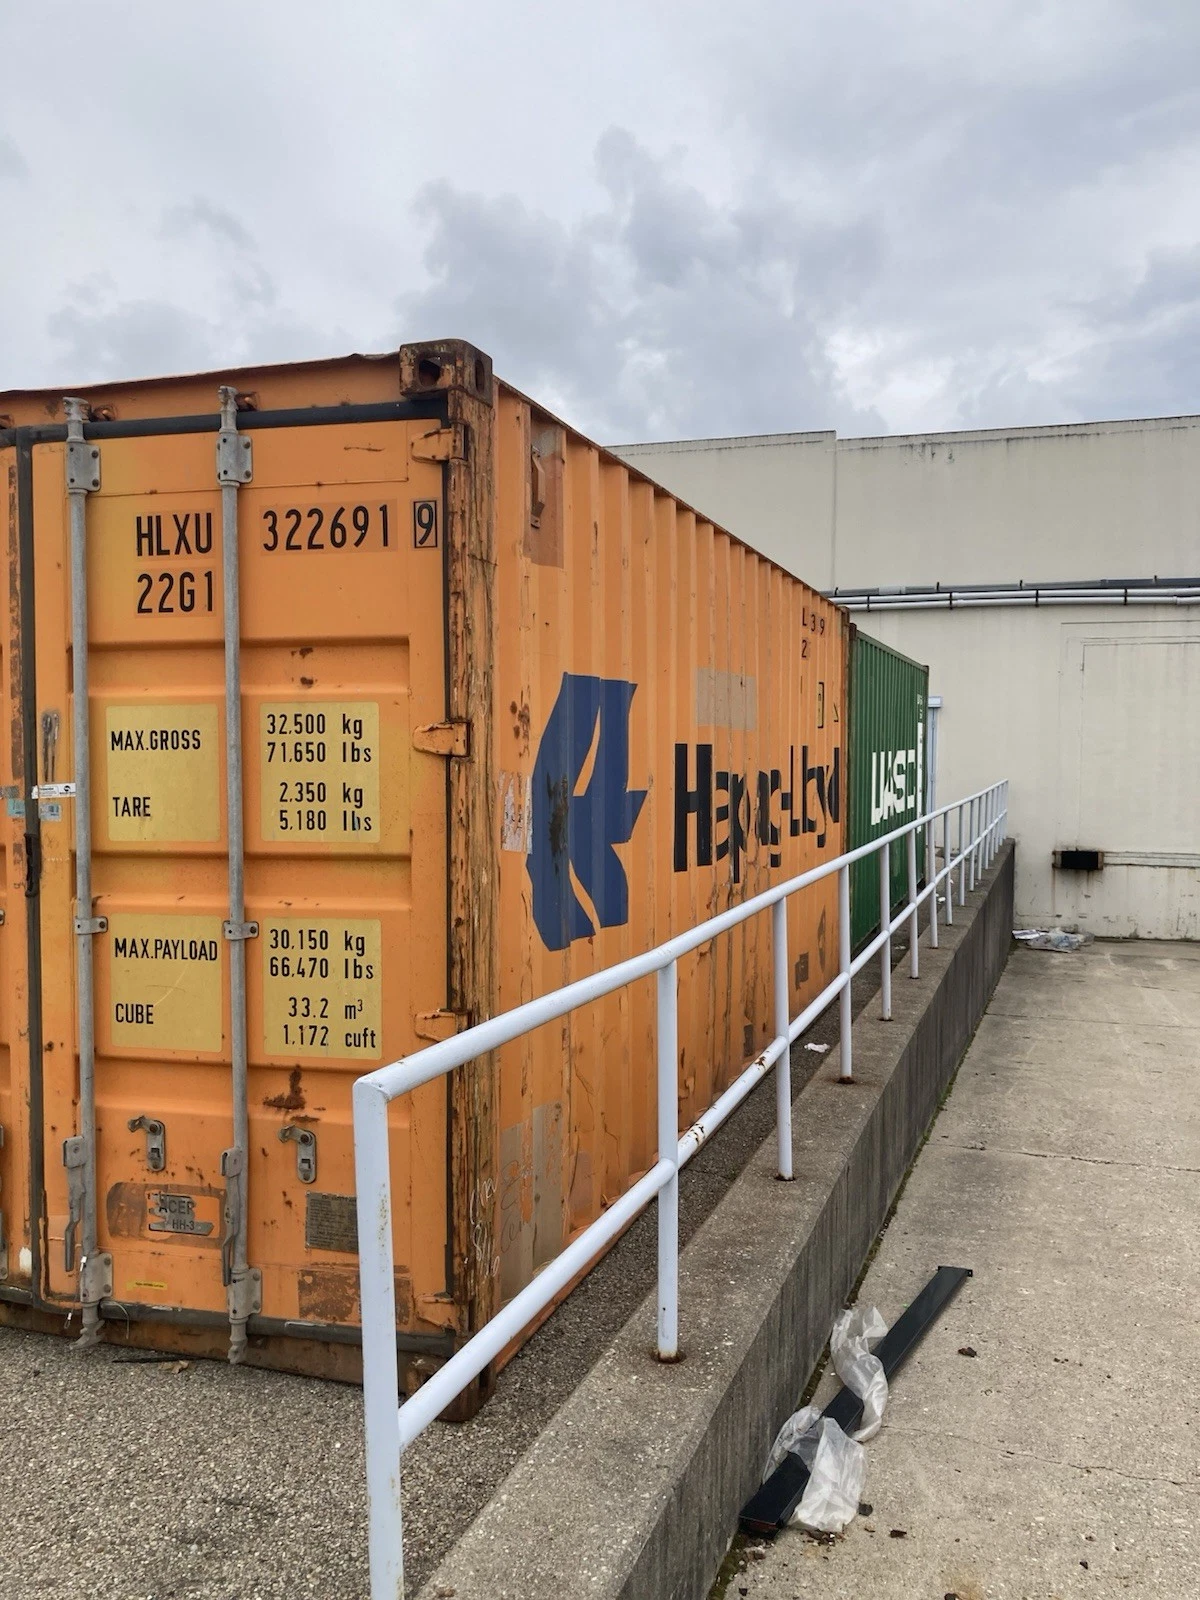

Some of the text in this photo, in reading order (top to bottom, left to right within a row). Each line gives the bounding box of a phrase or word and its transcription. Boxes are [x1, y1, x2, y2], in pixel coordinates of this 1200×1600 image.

[136, 502, 436, 557] HLXU 322691 9
[137, 570, 213, 614] 22G1
[342, 713, 363, 741] kg
[111, 729, 201, 751] MAX.GROSS
[342, 741, 372, 763] lbs
[112, 796, 151, 817] TARE
[342, 782, 363, 809] kg
[343, 809, 372, 831] lbs
[114, 937, 218, 961] MAX.PAYLOAD
[344, 930, 365, 957] kg
[344, 958, 374, 980] lbs
[115, 1003, 154, 1025] CUBE
[288, 996, 329, 1019] 33.2
[344, 1027, 376, 1049] cuft
[172, 1219, 194, 1231] HH-3
